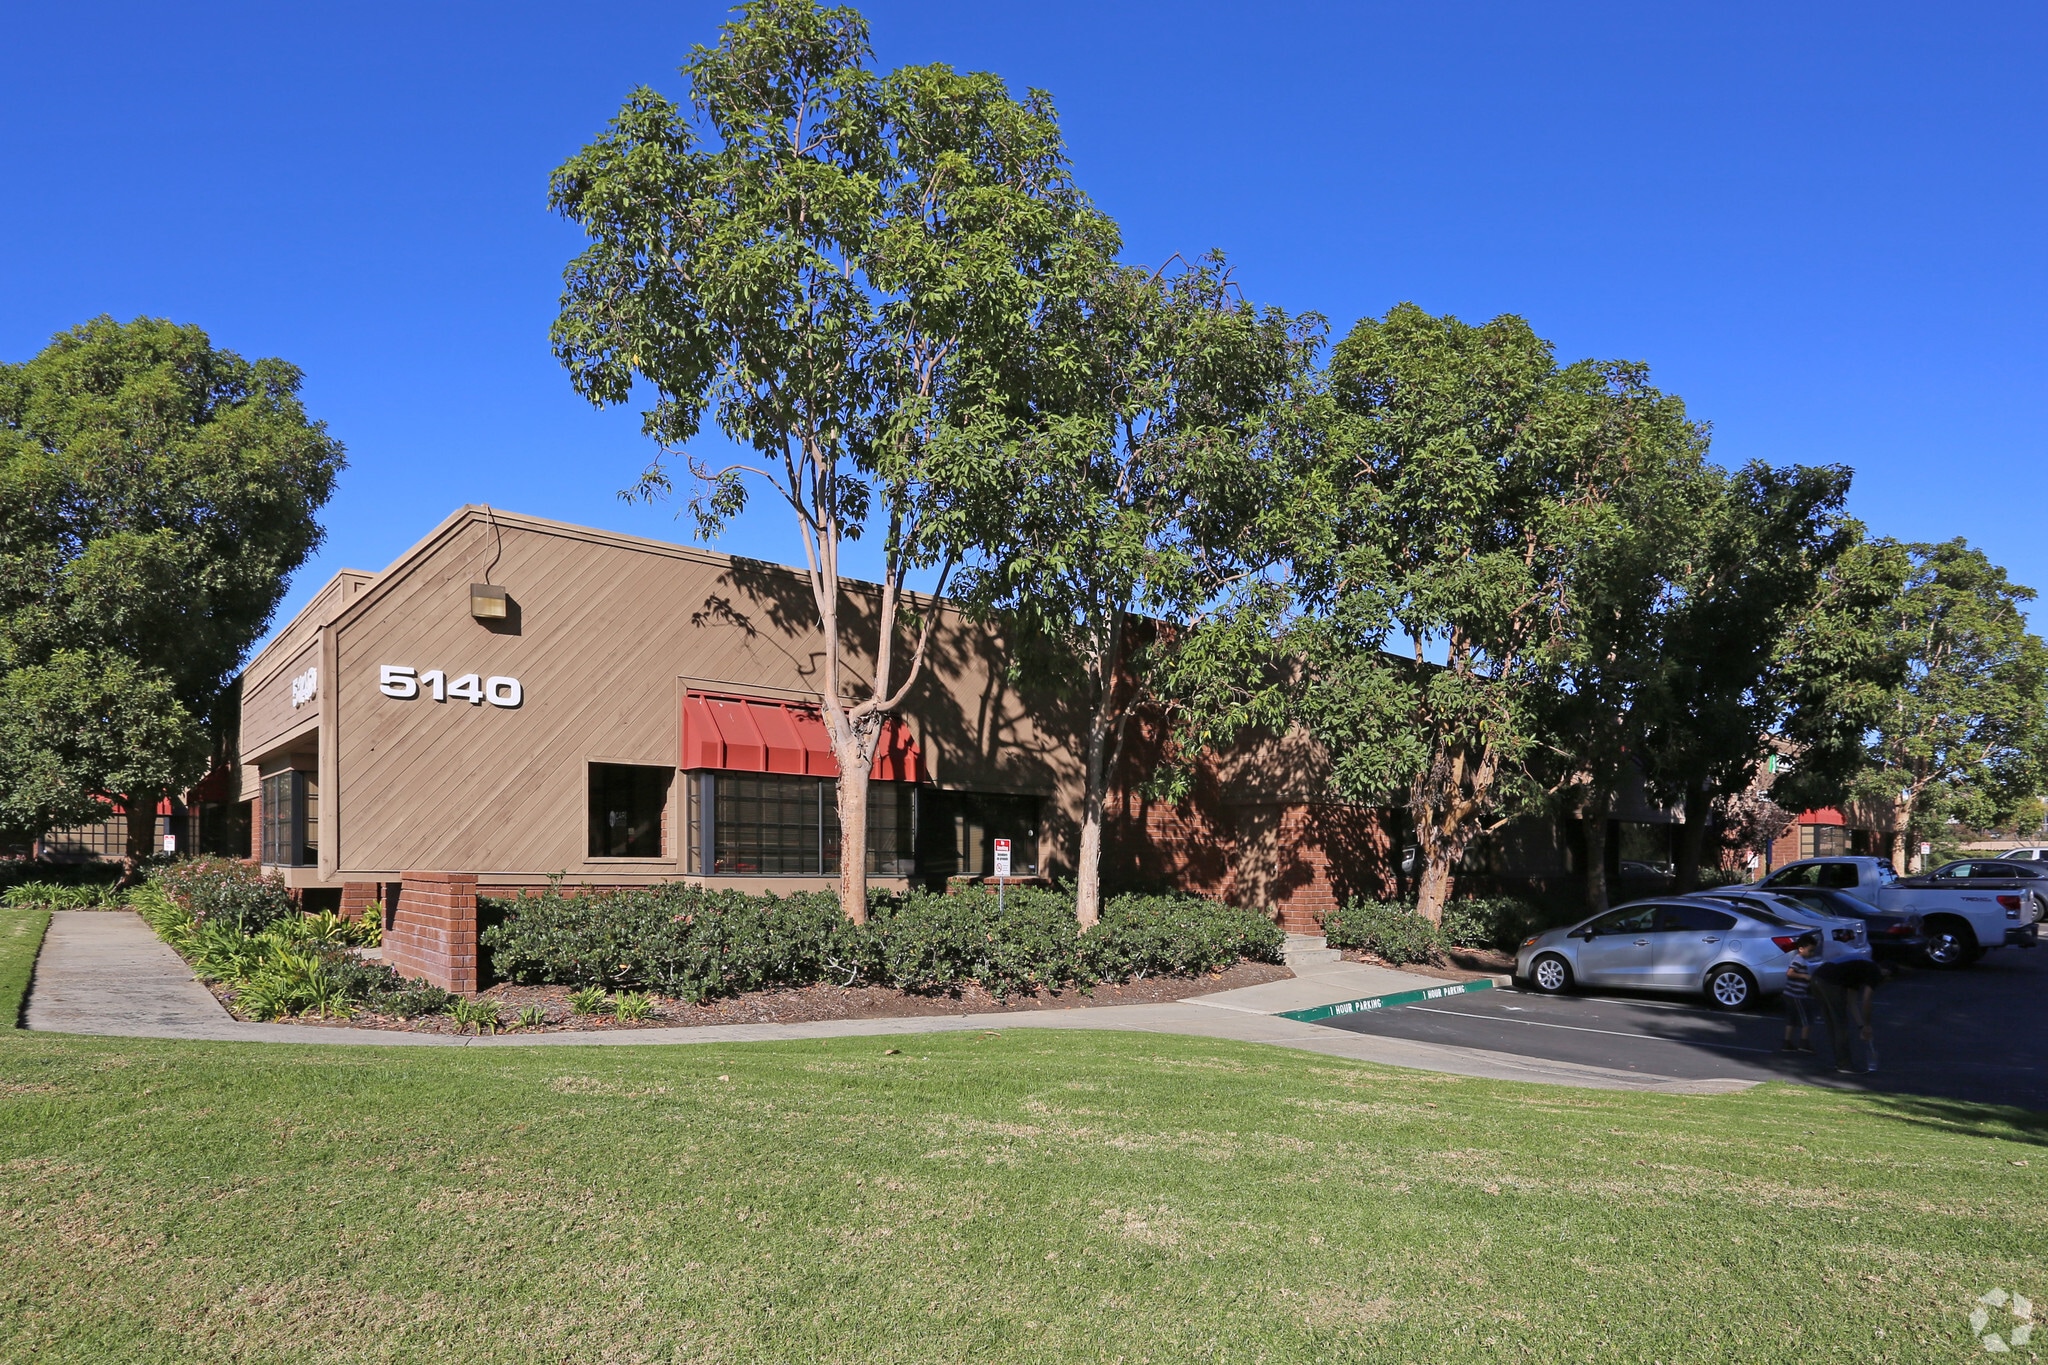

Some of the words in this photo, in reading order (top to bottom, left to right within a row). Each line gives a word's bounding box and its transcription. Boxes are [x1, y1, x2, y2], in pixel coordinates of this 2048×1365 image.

[380, 665, 521, 707] 5140
[1422, 990, 1427, 1000] 1
[1427, 988, 1442, 999] HOUR
[1443, 985, 1465, 997] PARKING
[1329, 1006, 1334, 1016] 1
[1335, 1003, 1353, 1015] HOUR
[1355, 998, 1382, 1012] PARKING
